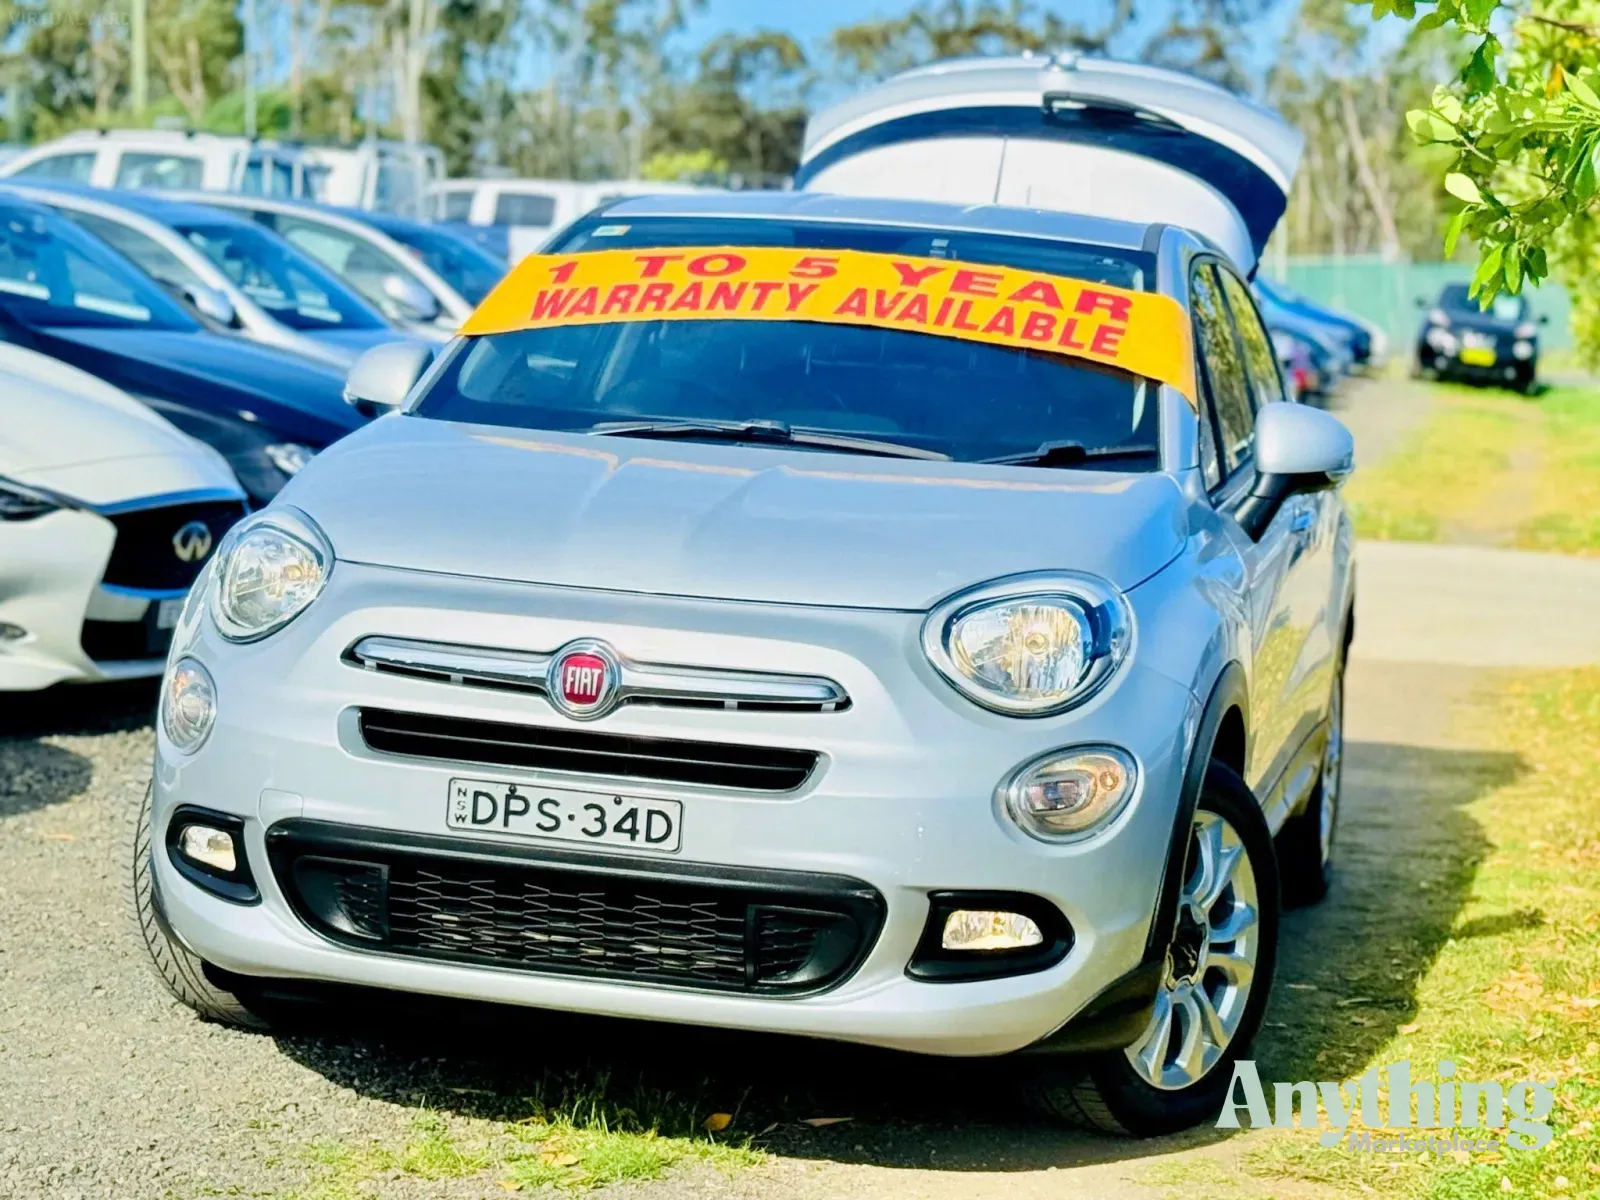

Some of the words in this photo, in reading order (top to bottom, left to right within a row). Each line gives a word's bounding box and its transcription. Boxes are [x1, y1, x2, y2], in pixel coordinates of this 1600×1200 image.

[530, 281, 820, 321] WARRANTY
[834, 287, 1126, 358] AVAILABLE
[548, 261, 578, 284] 1
[634, 253, 747, 278] TO
[789, 256, 840, 279] 5
[892, 262, 1133, 321] YEAR
[565, 666, 602, 696] FIAT
